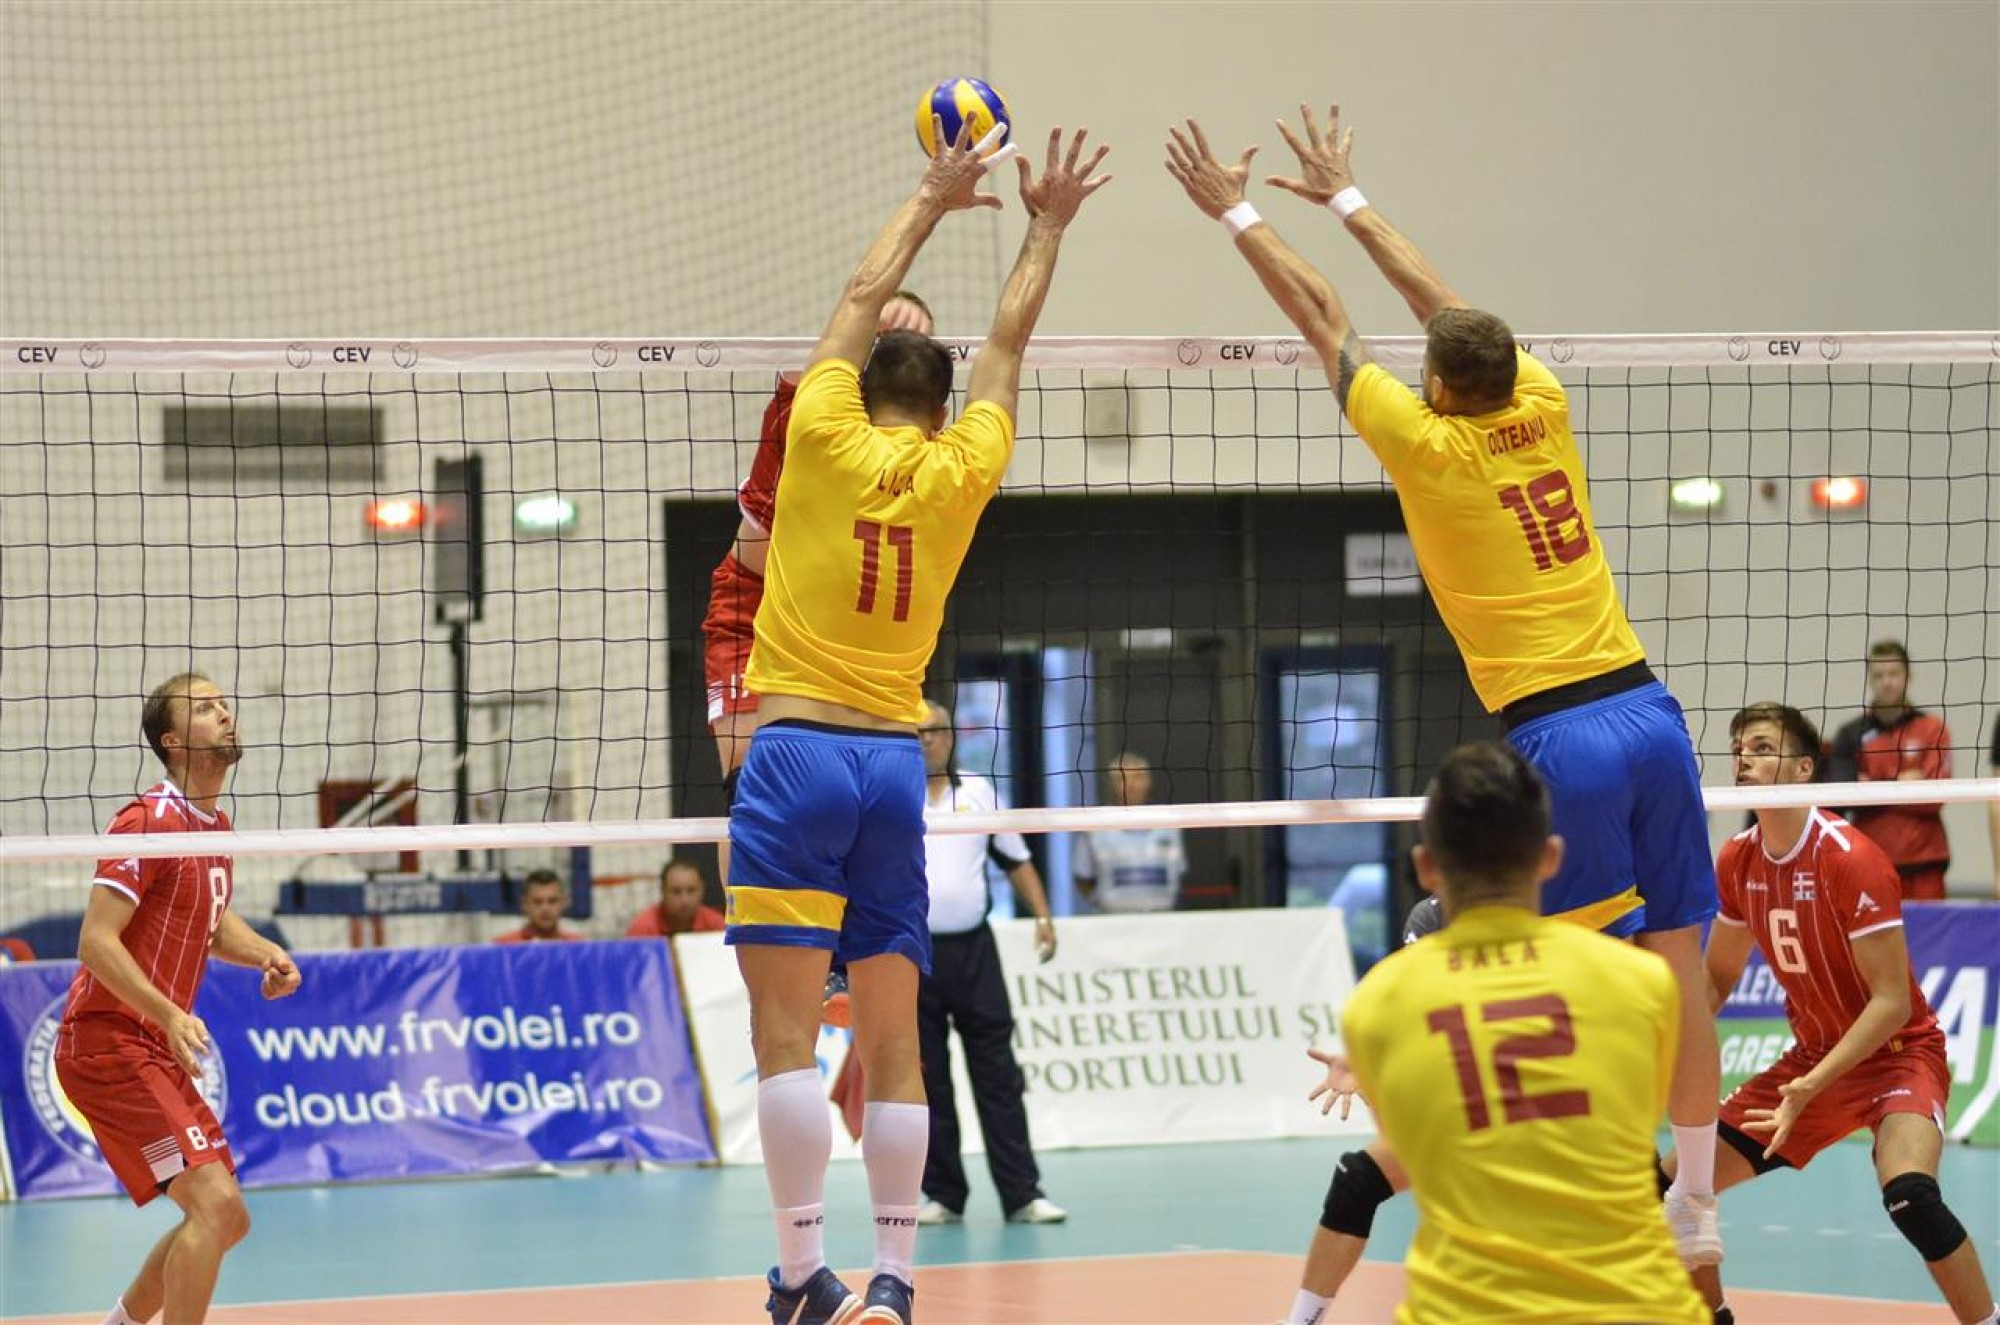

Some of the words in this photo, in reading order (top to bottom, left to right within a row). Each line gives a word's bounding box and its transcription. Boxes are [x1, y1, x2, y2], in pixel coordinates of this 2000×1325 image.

[18, 346, 58, 363] CEV
[333, 346, 371, 363] CEV
[638, 345, 675, 361] CEV
[949, 344, 970, 361] EV
[1220, 343, 1256, 360] CEV
[1768, 340, 1801, 356] CEV
[1498, 469, 1592, 571] 18
[853, 519, 914, 623] 11
[208, 866, 229, 933] 8
[1769, 908, 1807, 973] 6
[1016, 966, 1257, 1008] INISTERUL
[247, 1004, 641, 1062] www.frvolei.ro
[1012, 1004, 1282, 1050] INERETULUI
[1018, 1052, 1244, 1095] PORTULUI
[1425, 993, 1591, 1133] 12
[255, 1071, 664, 1129] cloud.frvolei.ro
[185, 1125, 208, 1151] 8
